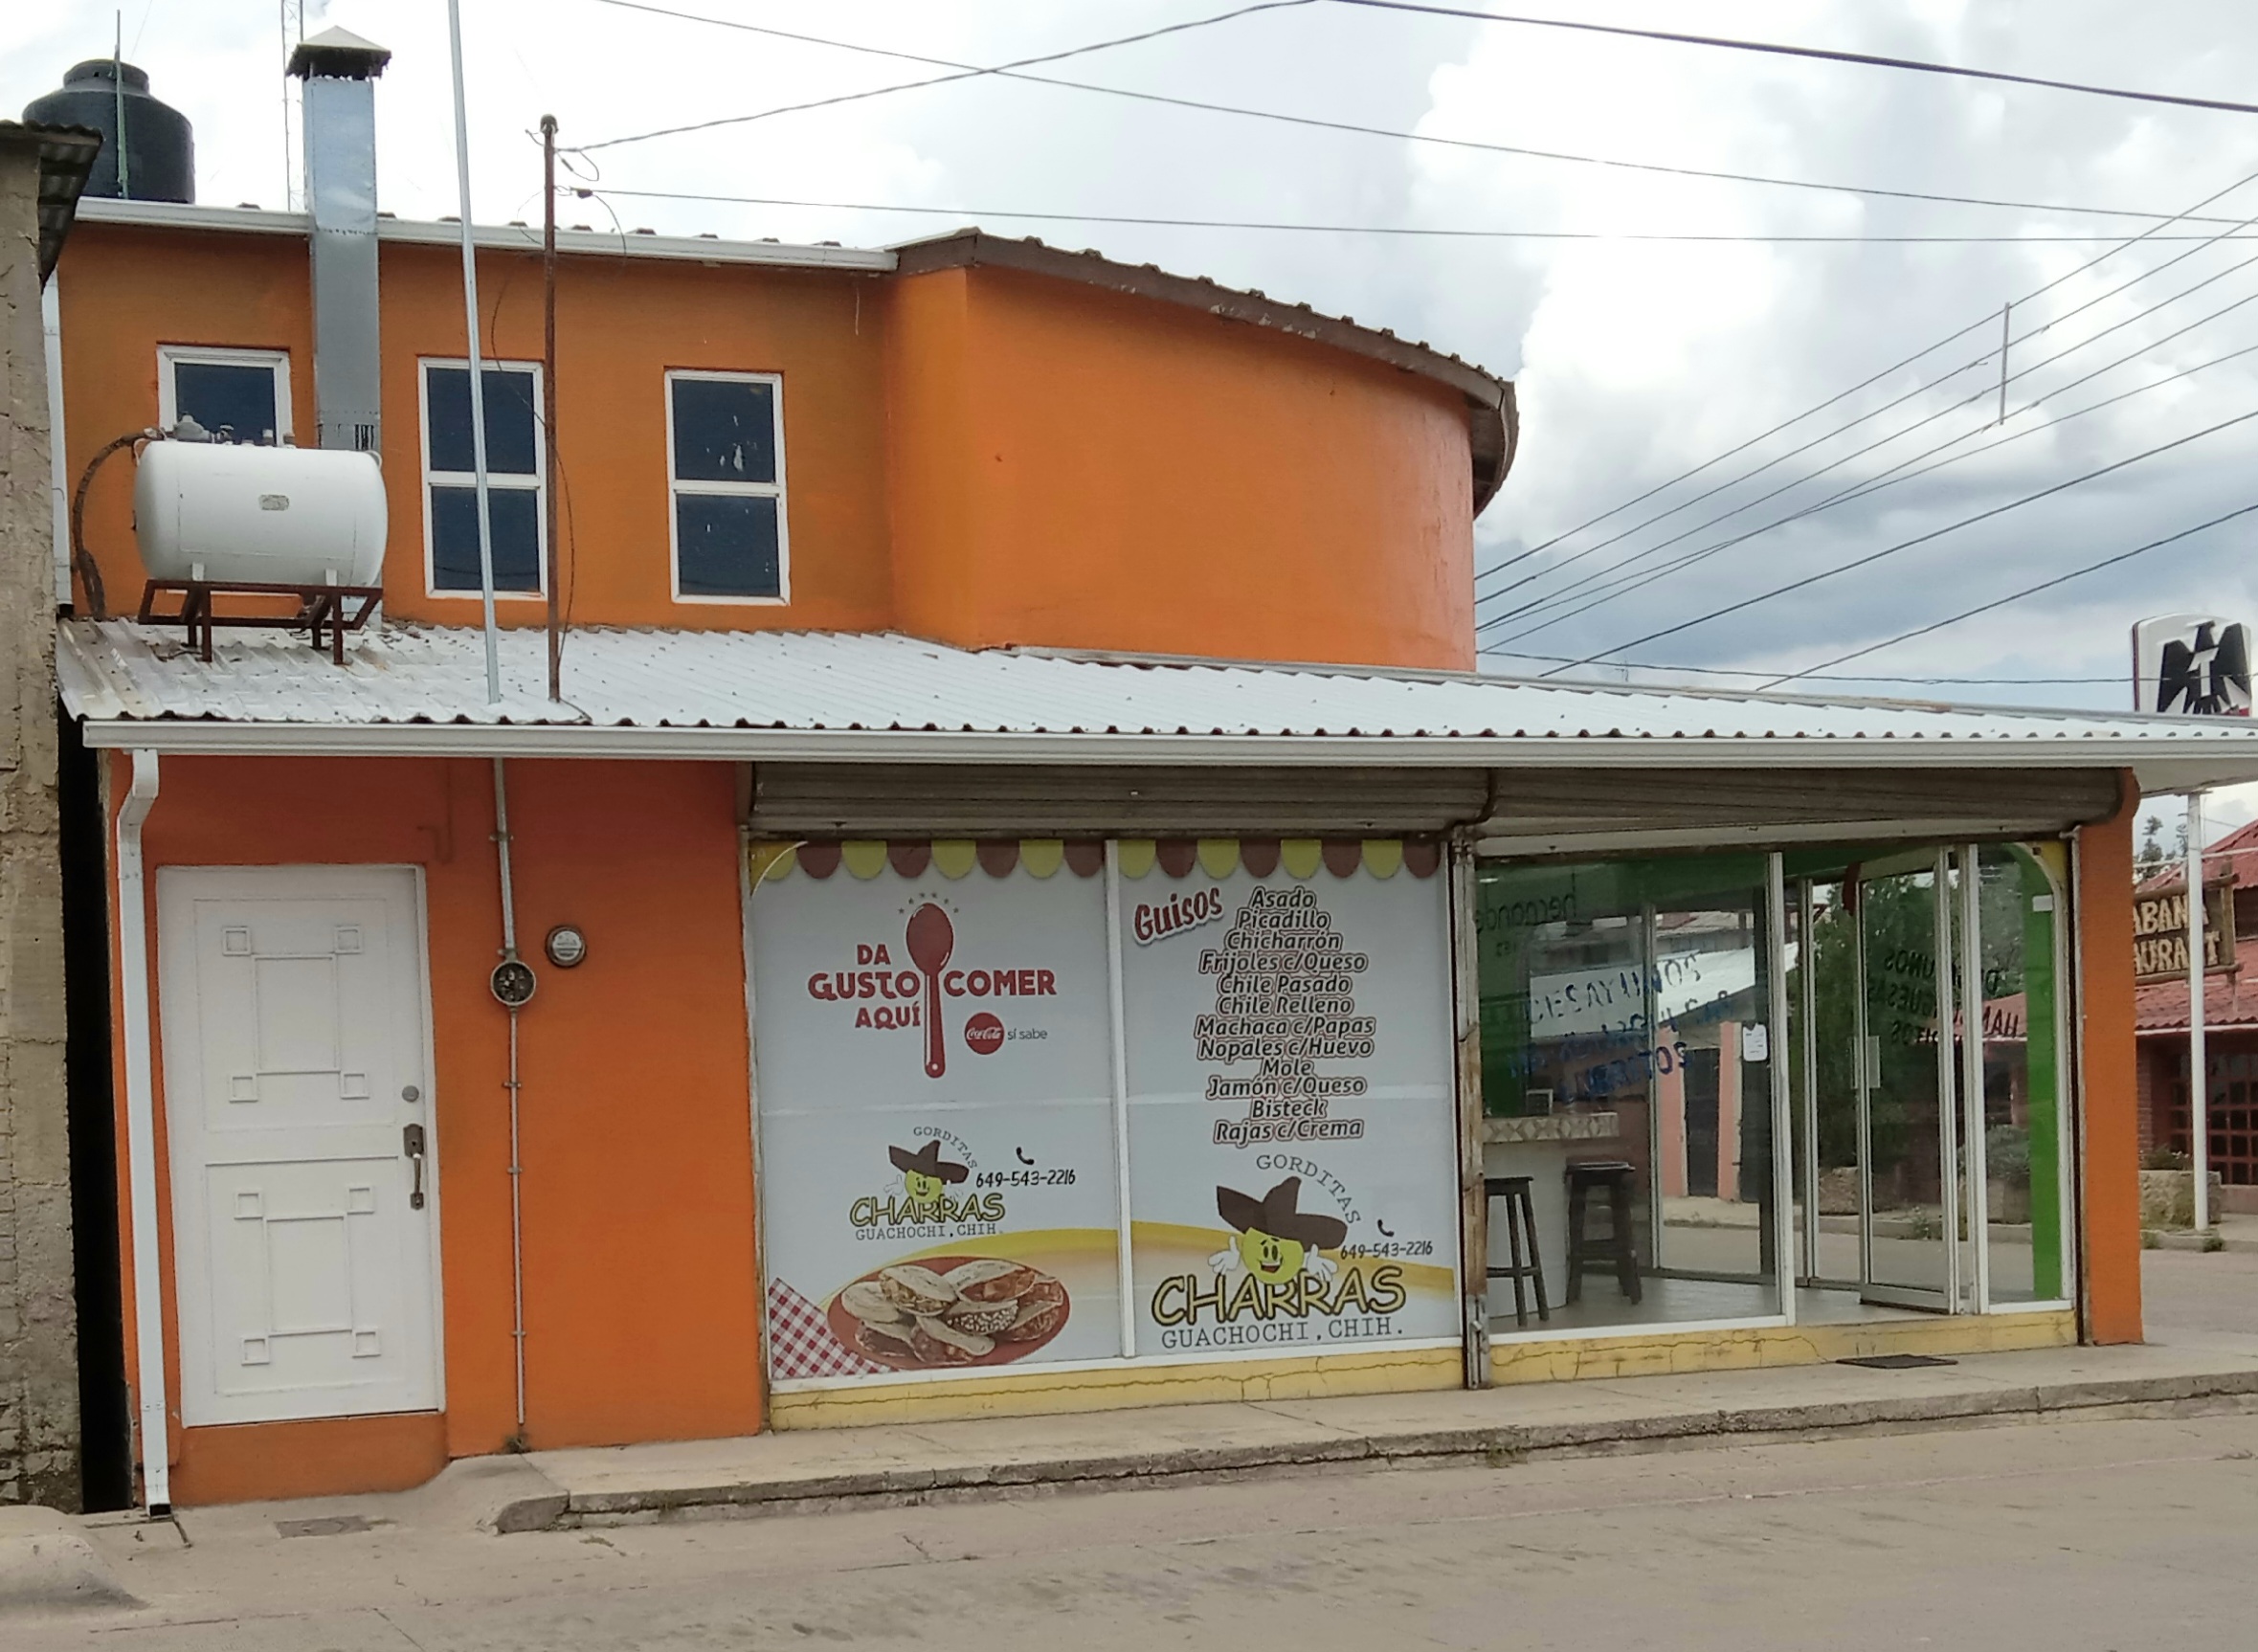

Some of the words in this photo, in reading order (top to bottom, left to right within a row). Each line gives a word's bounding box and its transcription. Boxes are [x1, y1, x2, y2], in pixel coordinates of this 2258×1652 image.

[1251, 888, 1316, 908] Asado
[1238, 910, 1330, 931] Picadillo
[1226, 931, 1341, 950] Chicharrón
[857, 944, 891, 966] DA
[1200, 952, 1279, 974] Frijoles
[1283, 953, 1367, 973] c/Queso
[808, 971, 921, 1001] GUSTO
[944, 970, 1057, 997] COMER
[1219, 975, 1271, 993] Chile
[1277, 975, 1351, 993] Pasado
[855, 1001, 921, 1030] AQUÍ
[1218, 996, 1270, 1016] Chile
[1276, 996, 1353, 1015] Relleno
[1008, 1028, 1017, 1040] sí
[1019, 1028, 1048, 1040] sabe
[1196, 1017, 1287, 1037] Machaca
[1293, 1016, 1375, 1038] c/Papas
[1199, 1039, 1283, 1061] Nopales
[1287, 1038, 1373, 1057] c/Huevo
[1263, 1058, 1312, 1078] Mole
[1208, 1078, 1276, 1099] Jamón
[1282, 1078, 1365, 1097] c/Queso
[1252, 1099, 1325, 1118] Bisteck
[1217, 1122, 1271, 1147] Rajas
[1277, 1119, 1362, 1139] c/Crema
[913, 1127, 978, 1170] GORDITAS
[976, 1169, 1076, 1188] 649-543-2216
[1256, 1154, 1362, 1225] GORDITAS
[849, 1193, 1006, 1226] CHARRAS
[1340, 1240, 1433, 1260] 649-543-2216
[1151, 1265, 1406, 1327] CHARRAS
